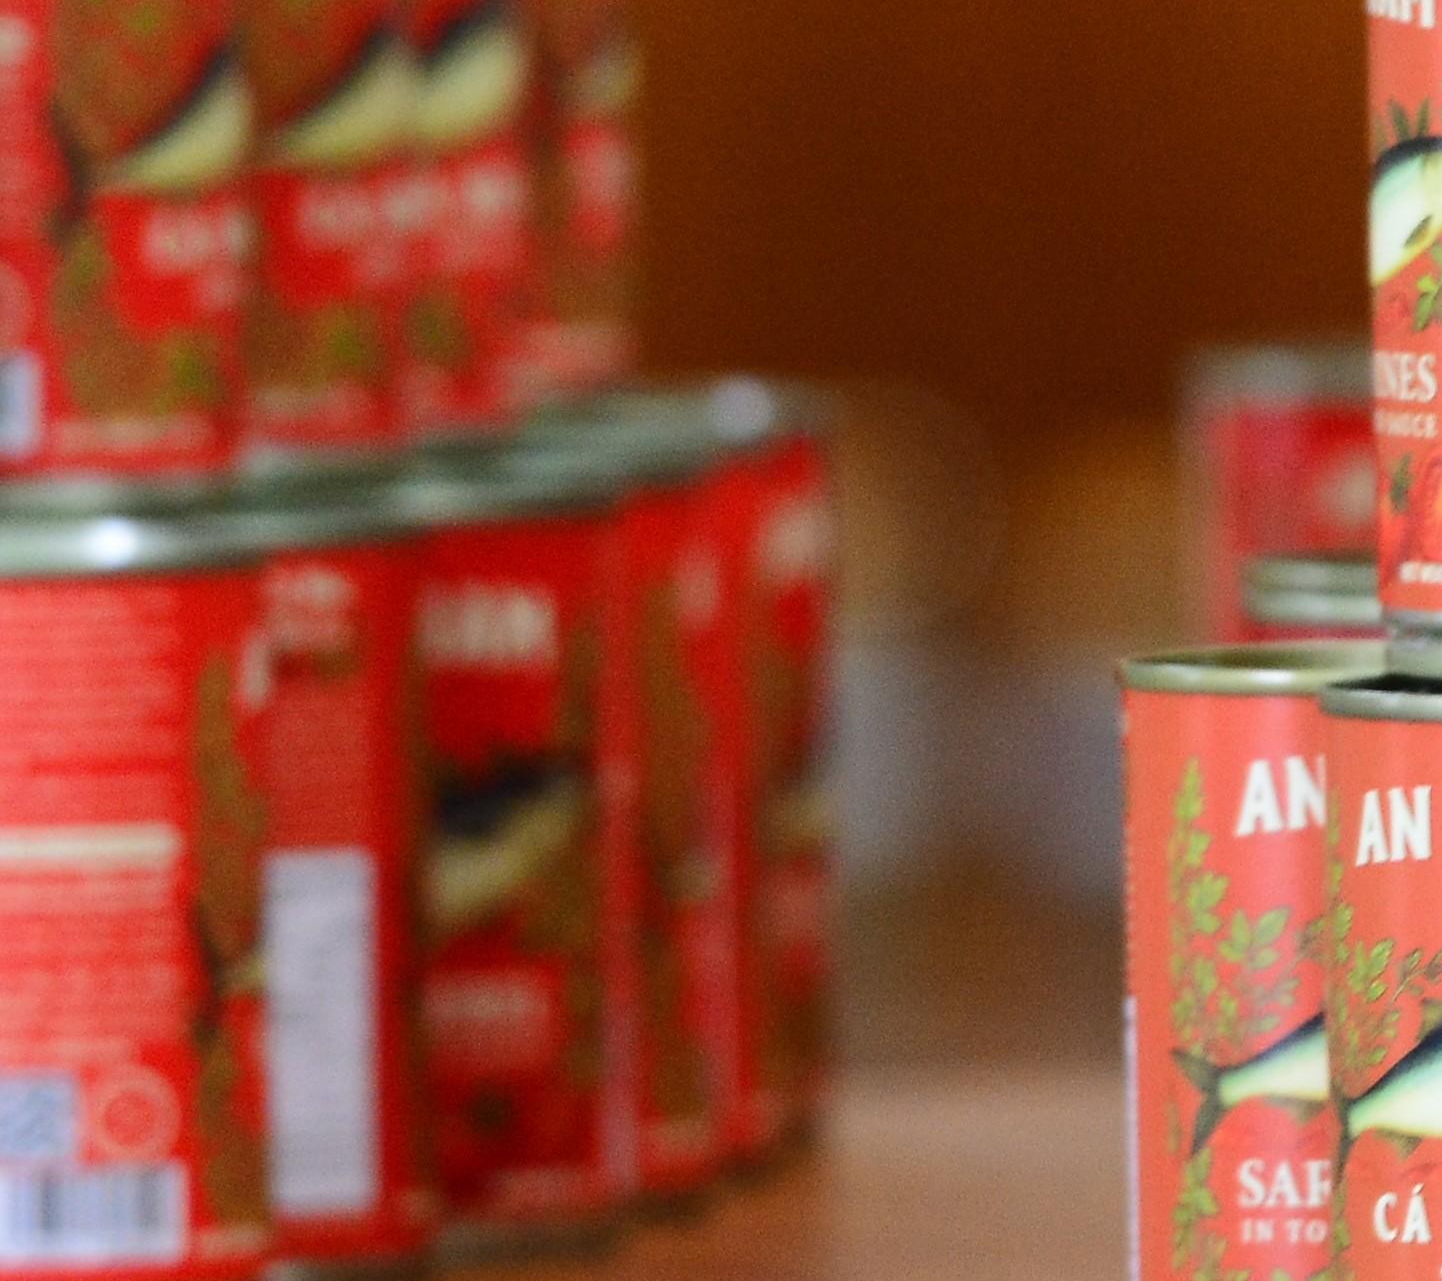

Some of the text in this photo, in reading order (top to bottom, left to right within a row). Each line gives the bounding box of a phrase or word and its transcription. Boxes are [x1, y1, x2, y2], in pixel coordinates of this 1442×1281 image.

[1232, 755, 1328, 839] AN
[1355, 787, 1434, 869] AN
[1373, 1183, 1432, 1245] CÁ
